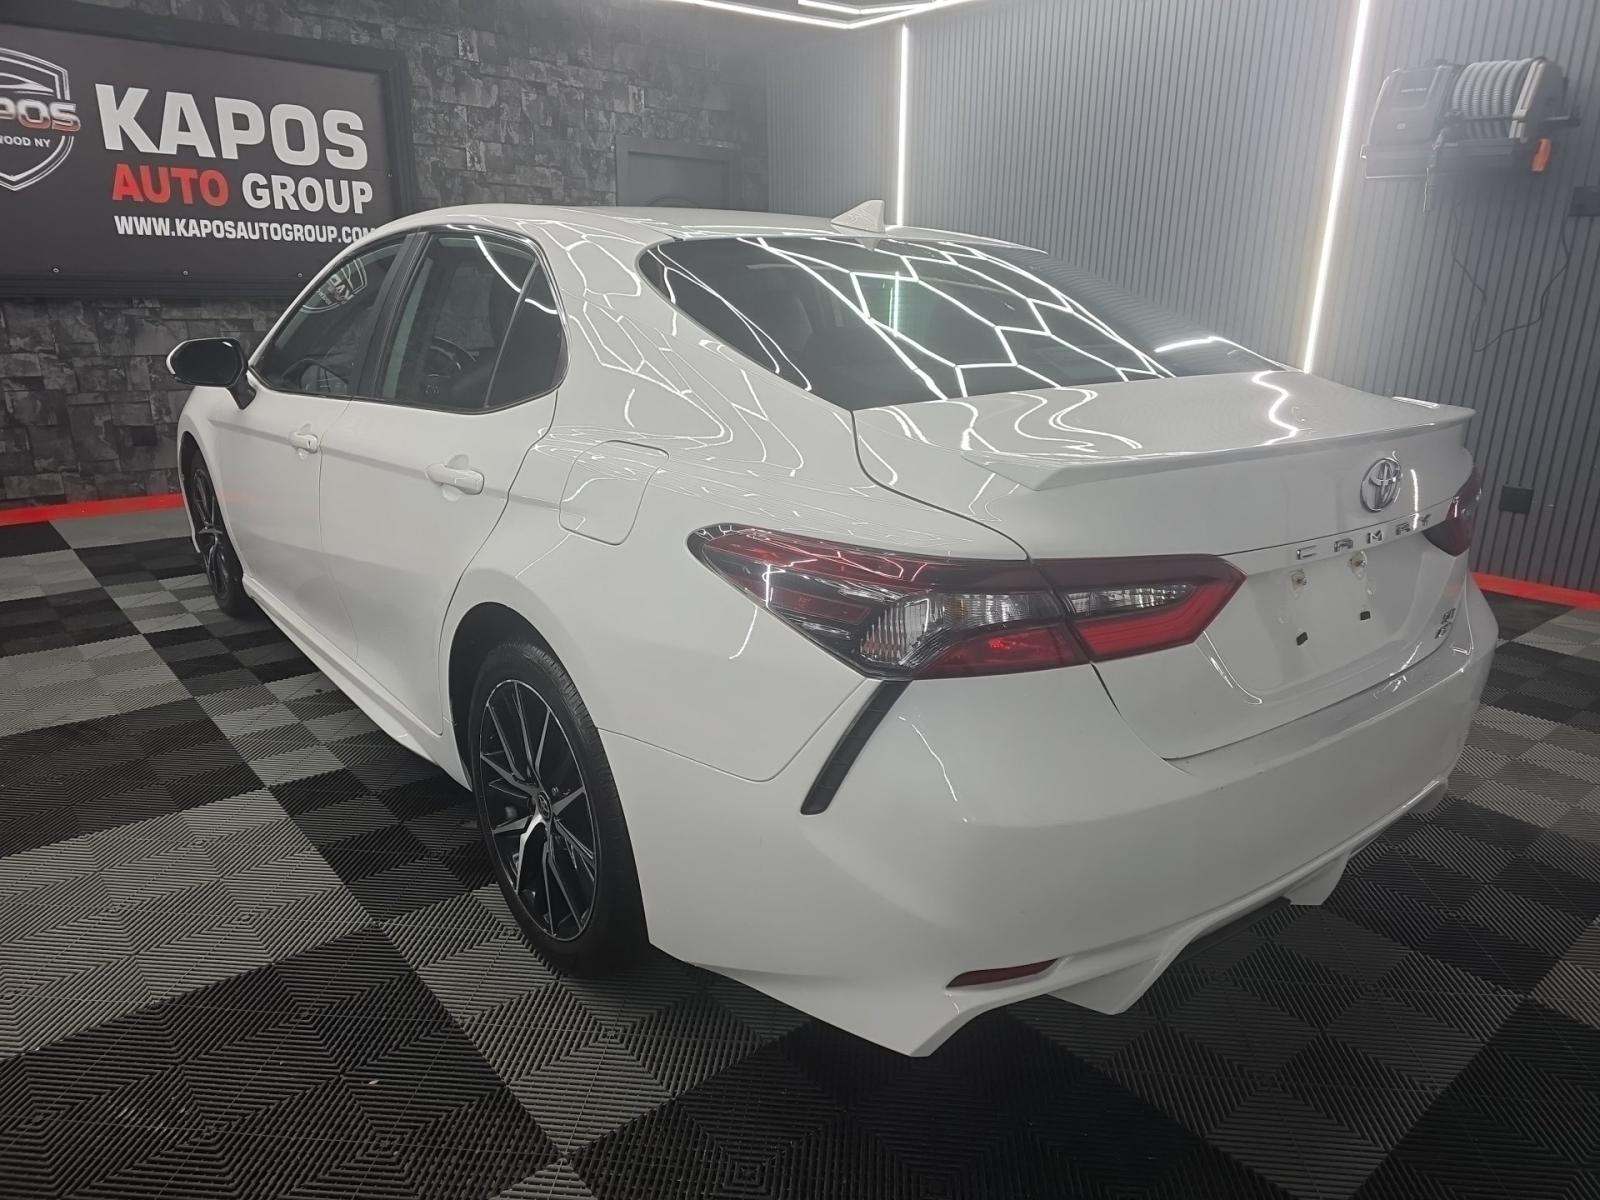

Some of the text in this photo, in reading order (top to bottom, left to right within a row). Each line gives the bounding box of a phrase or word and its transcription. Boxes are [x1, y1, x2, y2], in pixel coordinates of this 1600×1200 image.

[0, 134, 51, 148] OOD NY
[95, 83, 368, 170] KAPOS
[112, 163, 373, 214] AUTO GROUP
